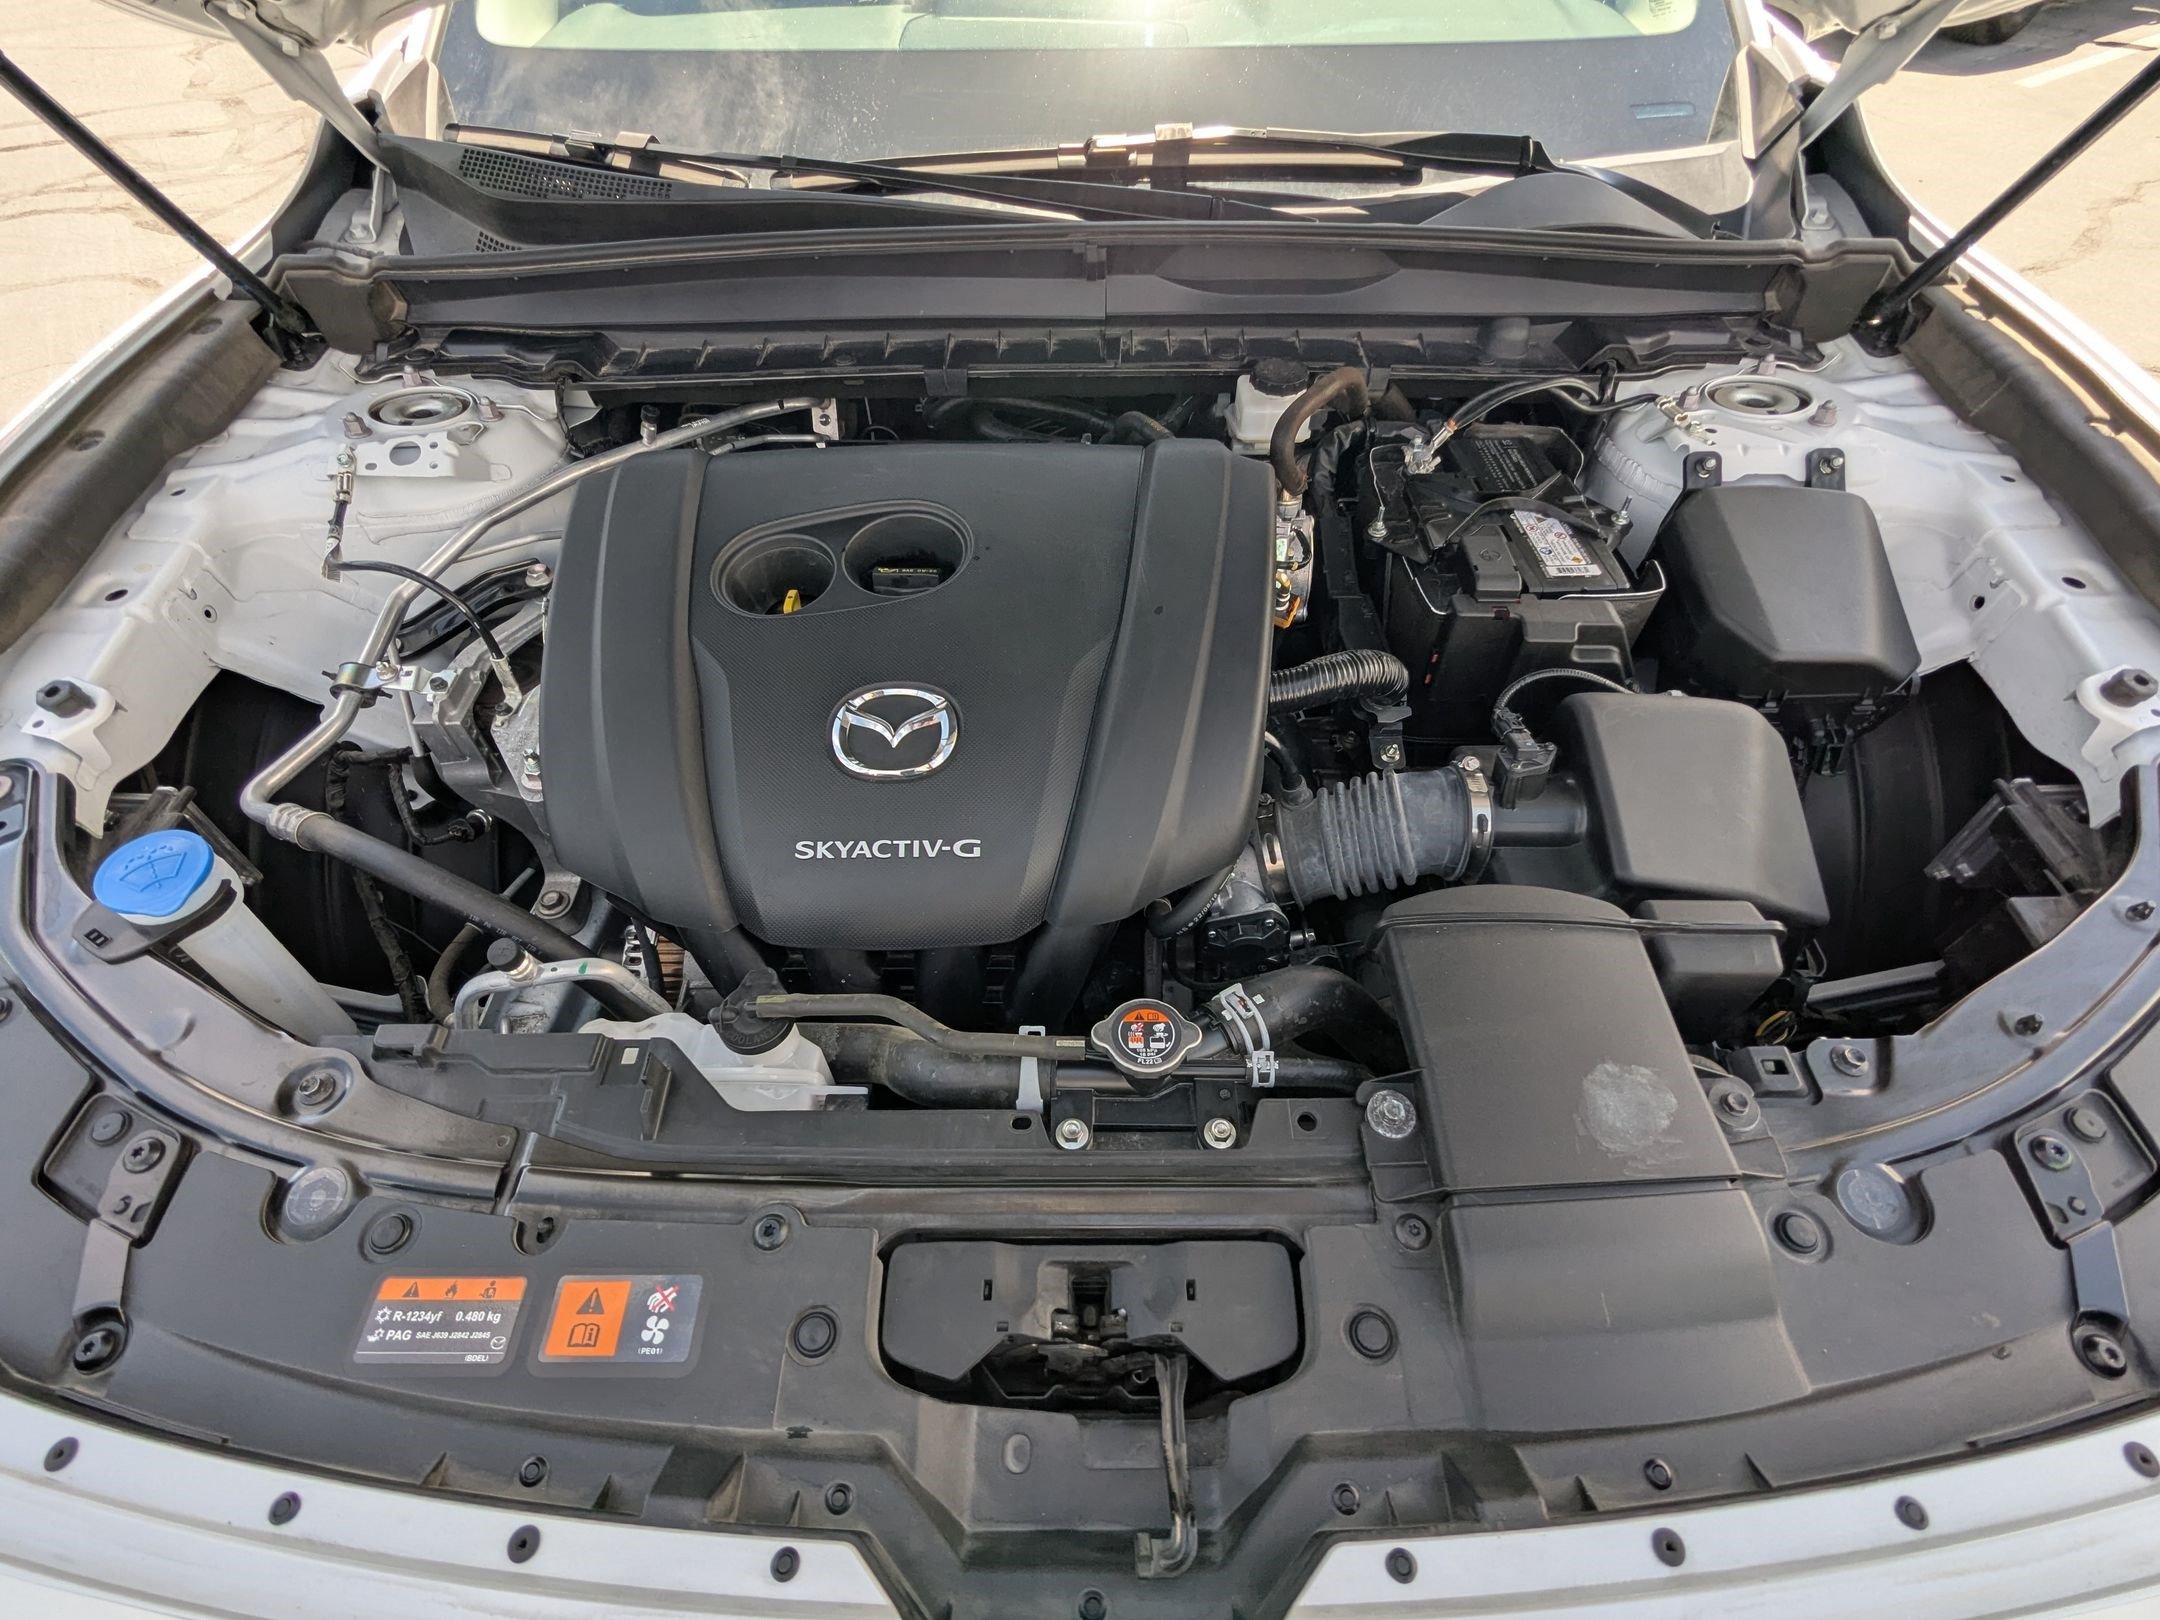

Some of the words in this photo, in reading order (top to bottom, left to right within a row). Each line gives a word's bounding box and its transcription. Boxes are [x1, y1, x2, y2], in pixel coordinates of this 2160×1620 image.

[795, 838, 982, 860] SKYACTIV-G
[392, 1310, 443, 1324] R-1234yf
[455, 1310, 485, 1322] 0.480
[486, 1310, 502, 1325] kg
[385, 1329, 412, 1341] PAG
[415, 1331, 432, 1339] SAE
[431, 1331, 448, 1339] J639
